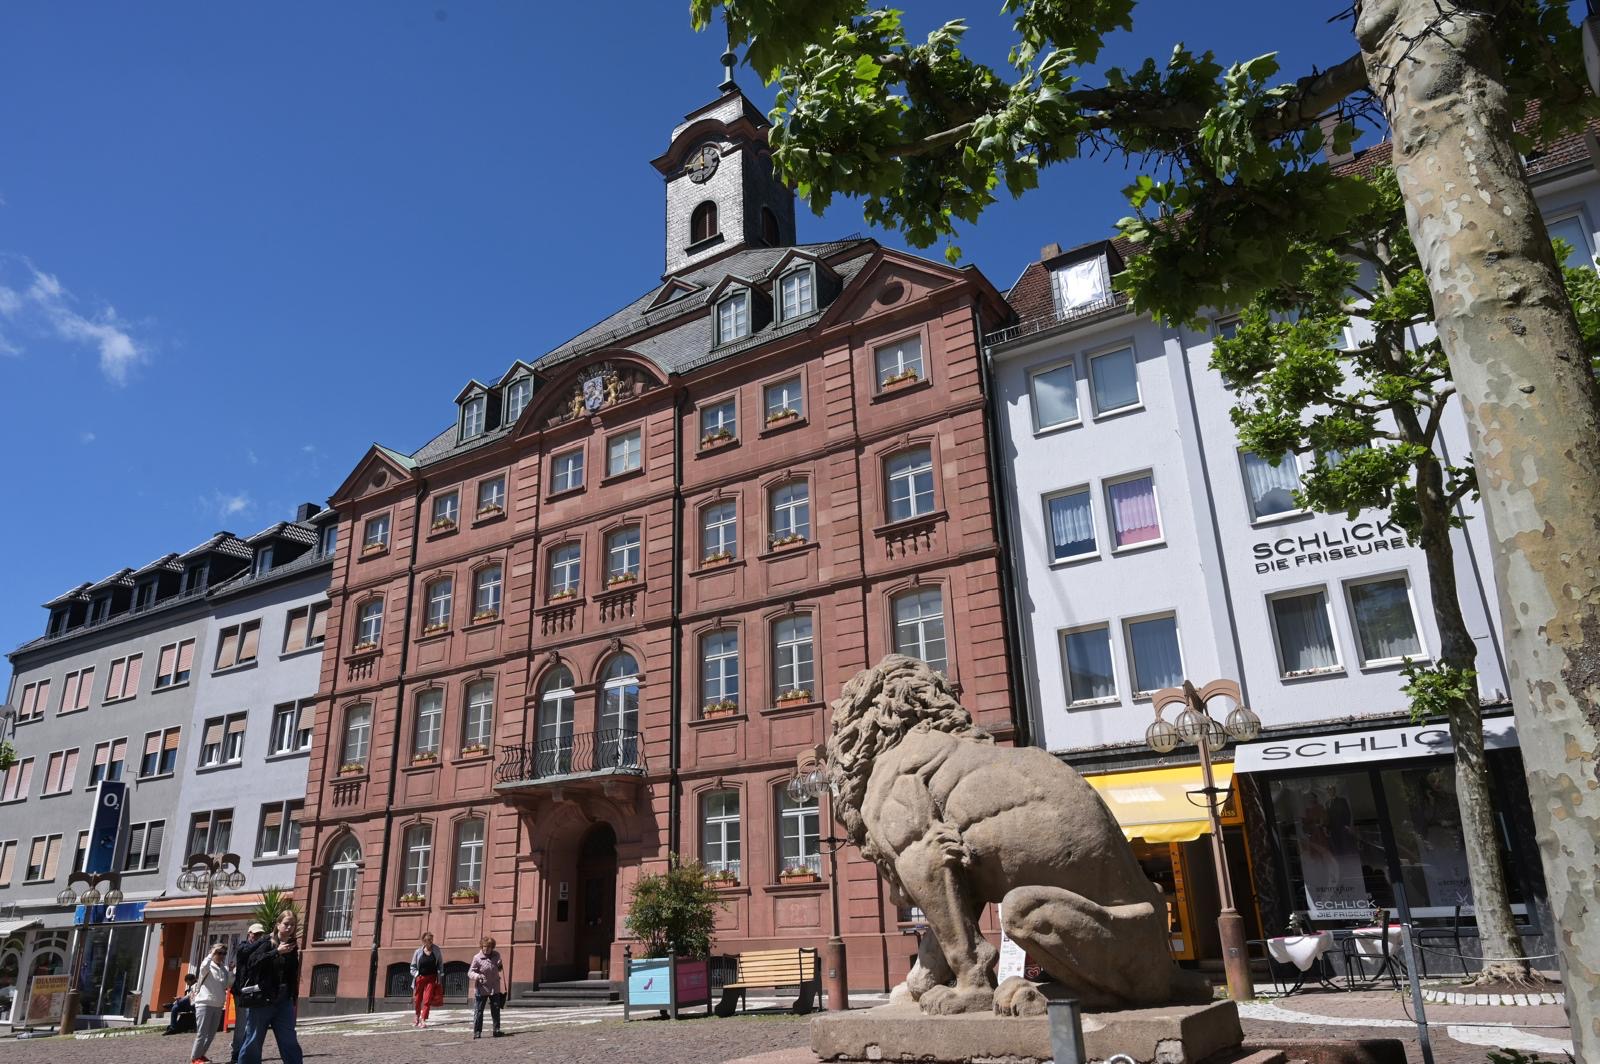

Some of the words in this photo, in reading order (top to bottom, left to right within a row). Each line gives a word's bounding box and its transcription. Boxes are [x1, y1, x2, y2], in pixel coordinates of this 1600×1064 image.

[1252, 519, 1402, 560] SCHLICK
[1255, 558, 1290, 575] DIE
[1295, 536, 1406, 567] FRISEURE
[1261, 729, 1450, 761] SCHLIC
[1315, 899, 1377, 909] SCHLICK
